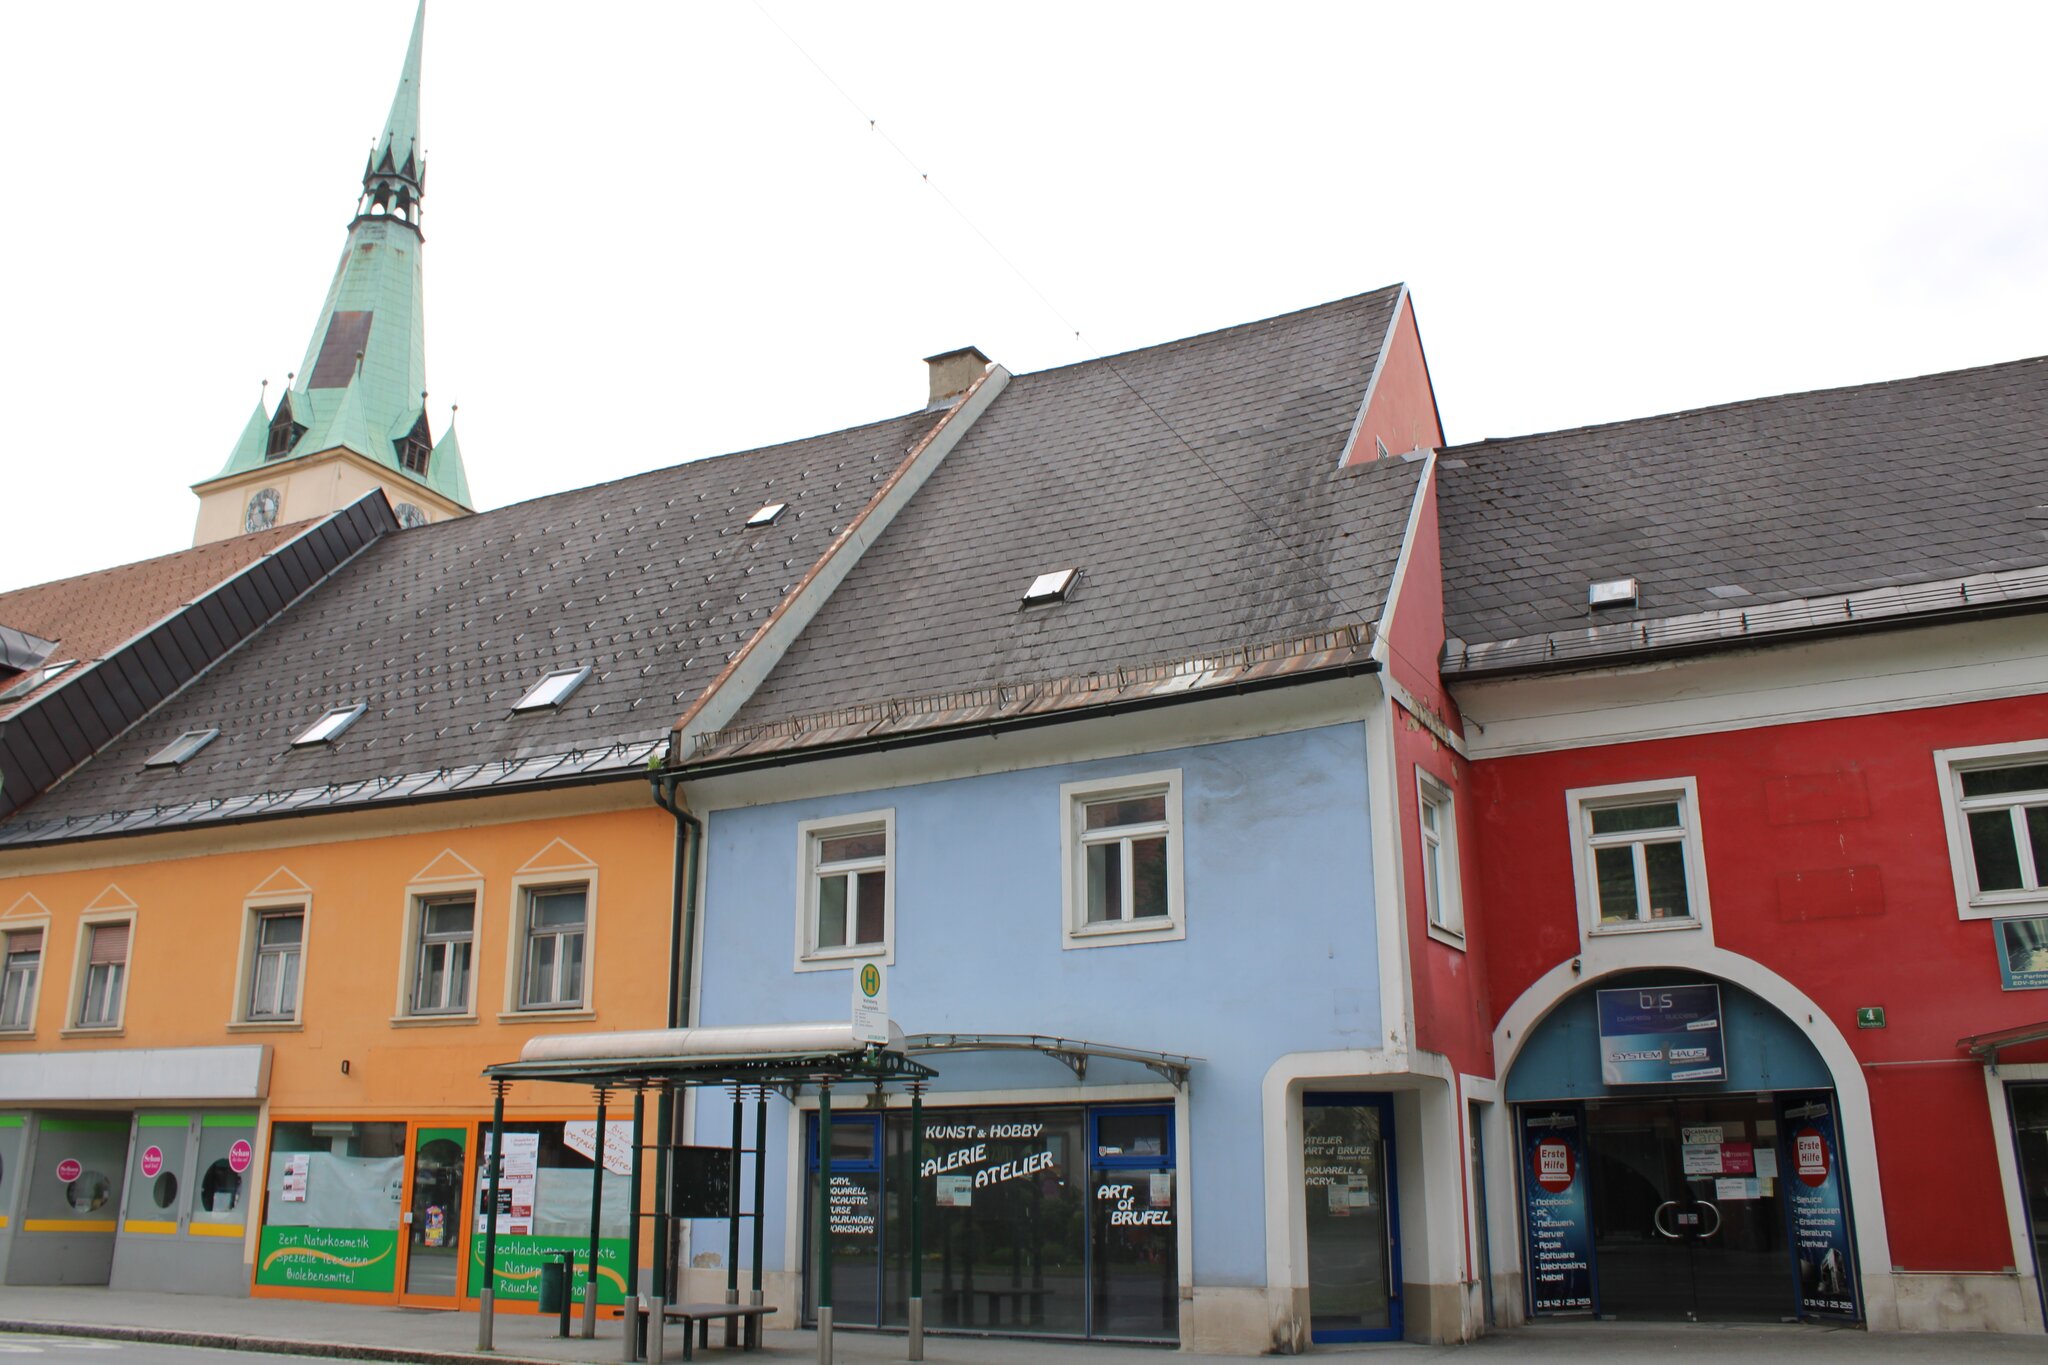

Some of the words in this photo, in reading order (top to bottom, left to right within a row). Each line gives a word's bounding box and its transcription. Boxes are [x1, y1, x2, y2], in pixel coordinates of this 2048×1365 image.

[1866, 1009, 1876, 1021] 4
[1611, 1051, 1661, 1060] SYSTEM
[1670, 1049, 1705, 1059] HAUS
[925, 1125, 976, 1139] KUNST
[977, 1128, 987, 1139] &
[990, 1123, 1043, 1139] HOBBY
[1304, 1136, 1343, 1145] ATELIER
[1800, 1141, 1819, 1150] Erste
[1304, 1147, 1324, 1155] ART
[1542, 1150, 1564, 1158] Erste
[921, 1144, 987, 1178] ALERIE
[1801, 1153, 1820, 1162] Hilfe
[975, 1151, 1054, 1188] ATELIER
[1305, 1166, 1354, 1175] AQUARELL
[1543, 1161, 1564, 1169] Hilfe
[1305, 1177, 1337, 1186] ACRYL
[1097, 1184, 1133, 1199] ART
[1117, 1196, 1135, 1211] of
[830, 1205, 851, 1214] URSE
[1111, 1210, 1172, 1225] BRUFEL
[830, 1224, 874, 1234] ORKSHOPS
[303, 1233, 369, 1248] Naturkosmetik
[276, 1250, 317, 1265] Spezielle
[322, 1253, 368, 1265] Teesorten
[286, 1267, 355, 1283] Biolebensmittel
